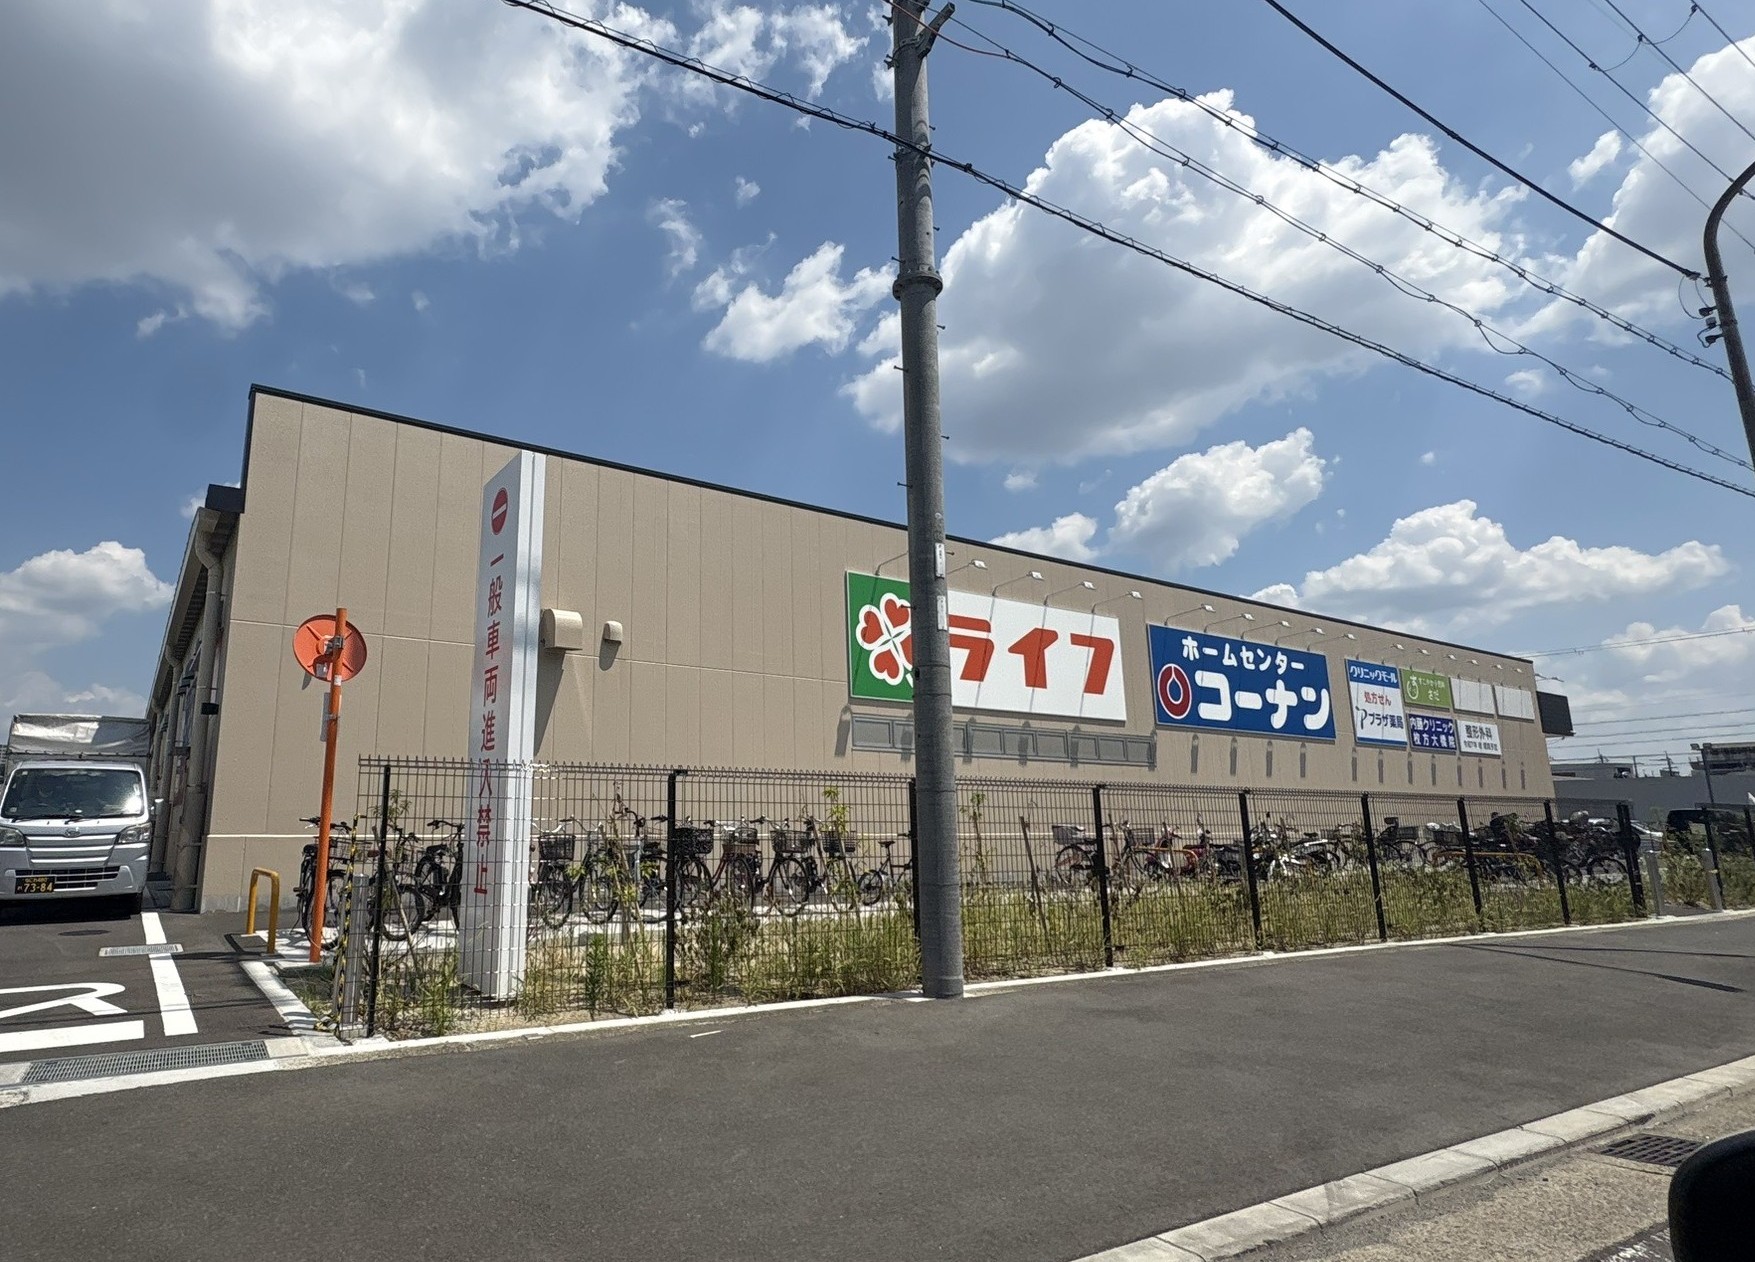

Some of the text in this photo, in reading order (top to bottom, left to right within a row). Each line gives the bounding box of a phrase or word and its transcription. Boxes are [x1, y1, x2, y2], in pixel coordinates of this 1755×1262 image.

[947, 614, 1115, 695] ライフ
[1181, 635, 1305, 675] ホームセンター
[1350, 665, 1398, 684] クリニックモール
[1194, 670, 1330, 731] コーナン
[1364, 690, 1392, 706] 処方せん
[474, 553, 504, 894] 一般車両進入禁止
[24, 882, 53, 893] 73-84
